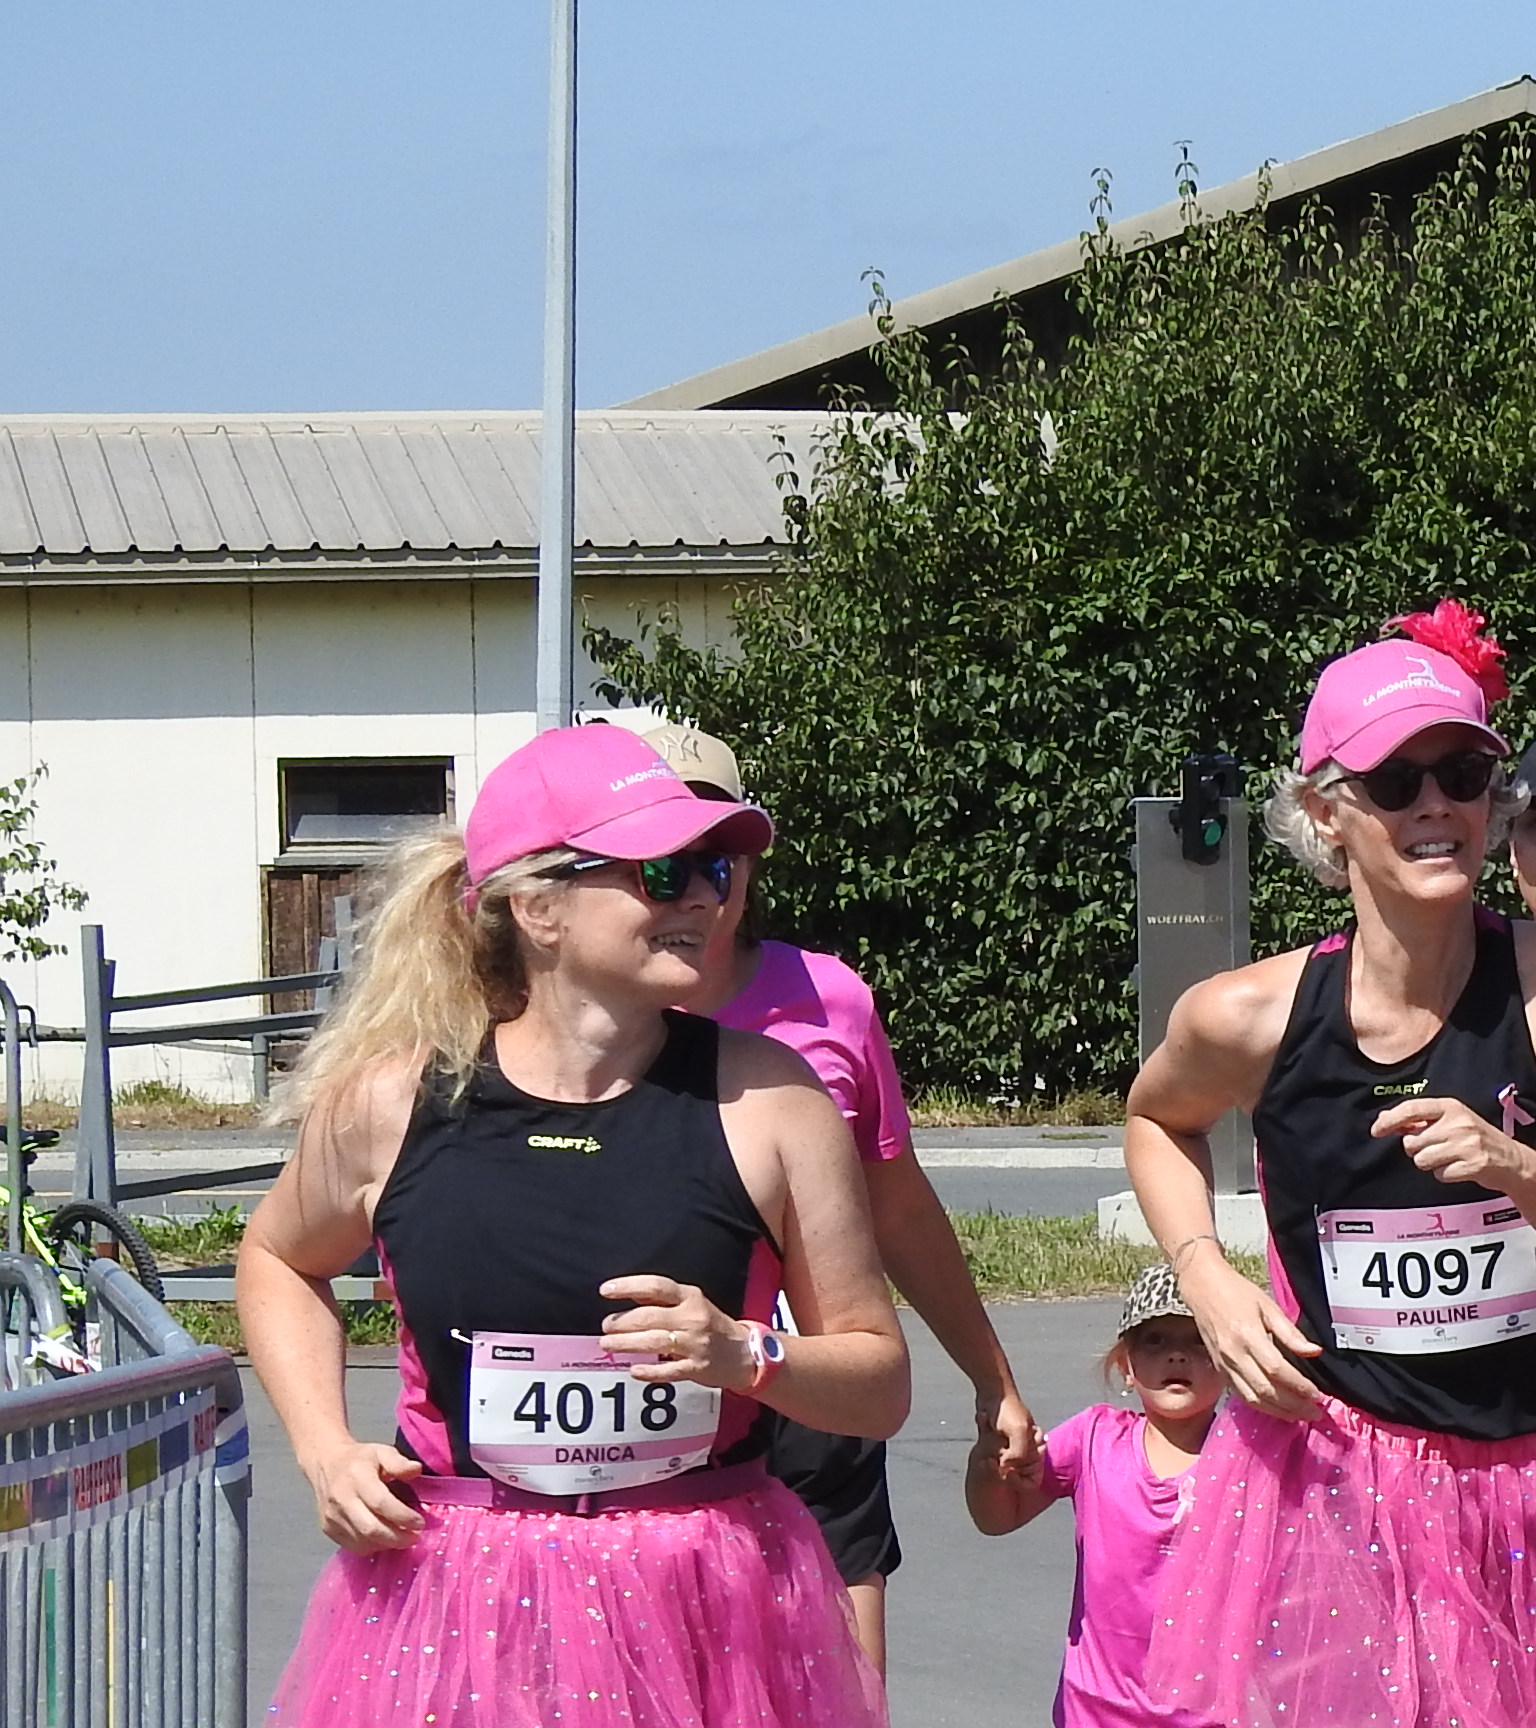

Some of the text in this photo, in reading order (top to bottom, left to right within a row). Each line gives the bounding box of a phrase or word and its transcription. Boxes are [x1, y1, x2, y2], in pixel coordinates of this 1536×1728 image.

[1373, 1082, 1422, 1096] CRAFT
[527, 1135, 587, 1150] CRAFT
[1362, 1240, 1506, 1299] 4097
[1396, 1304, 1479, 1326] PAULINE
[513, 1381, 678, 1434] 4018
[555, 1445, 636, 1463] DANICA
